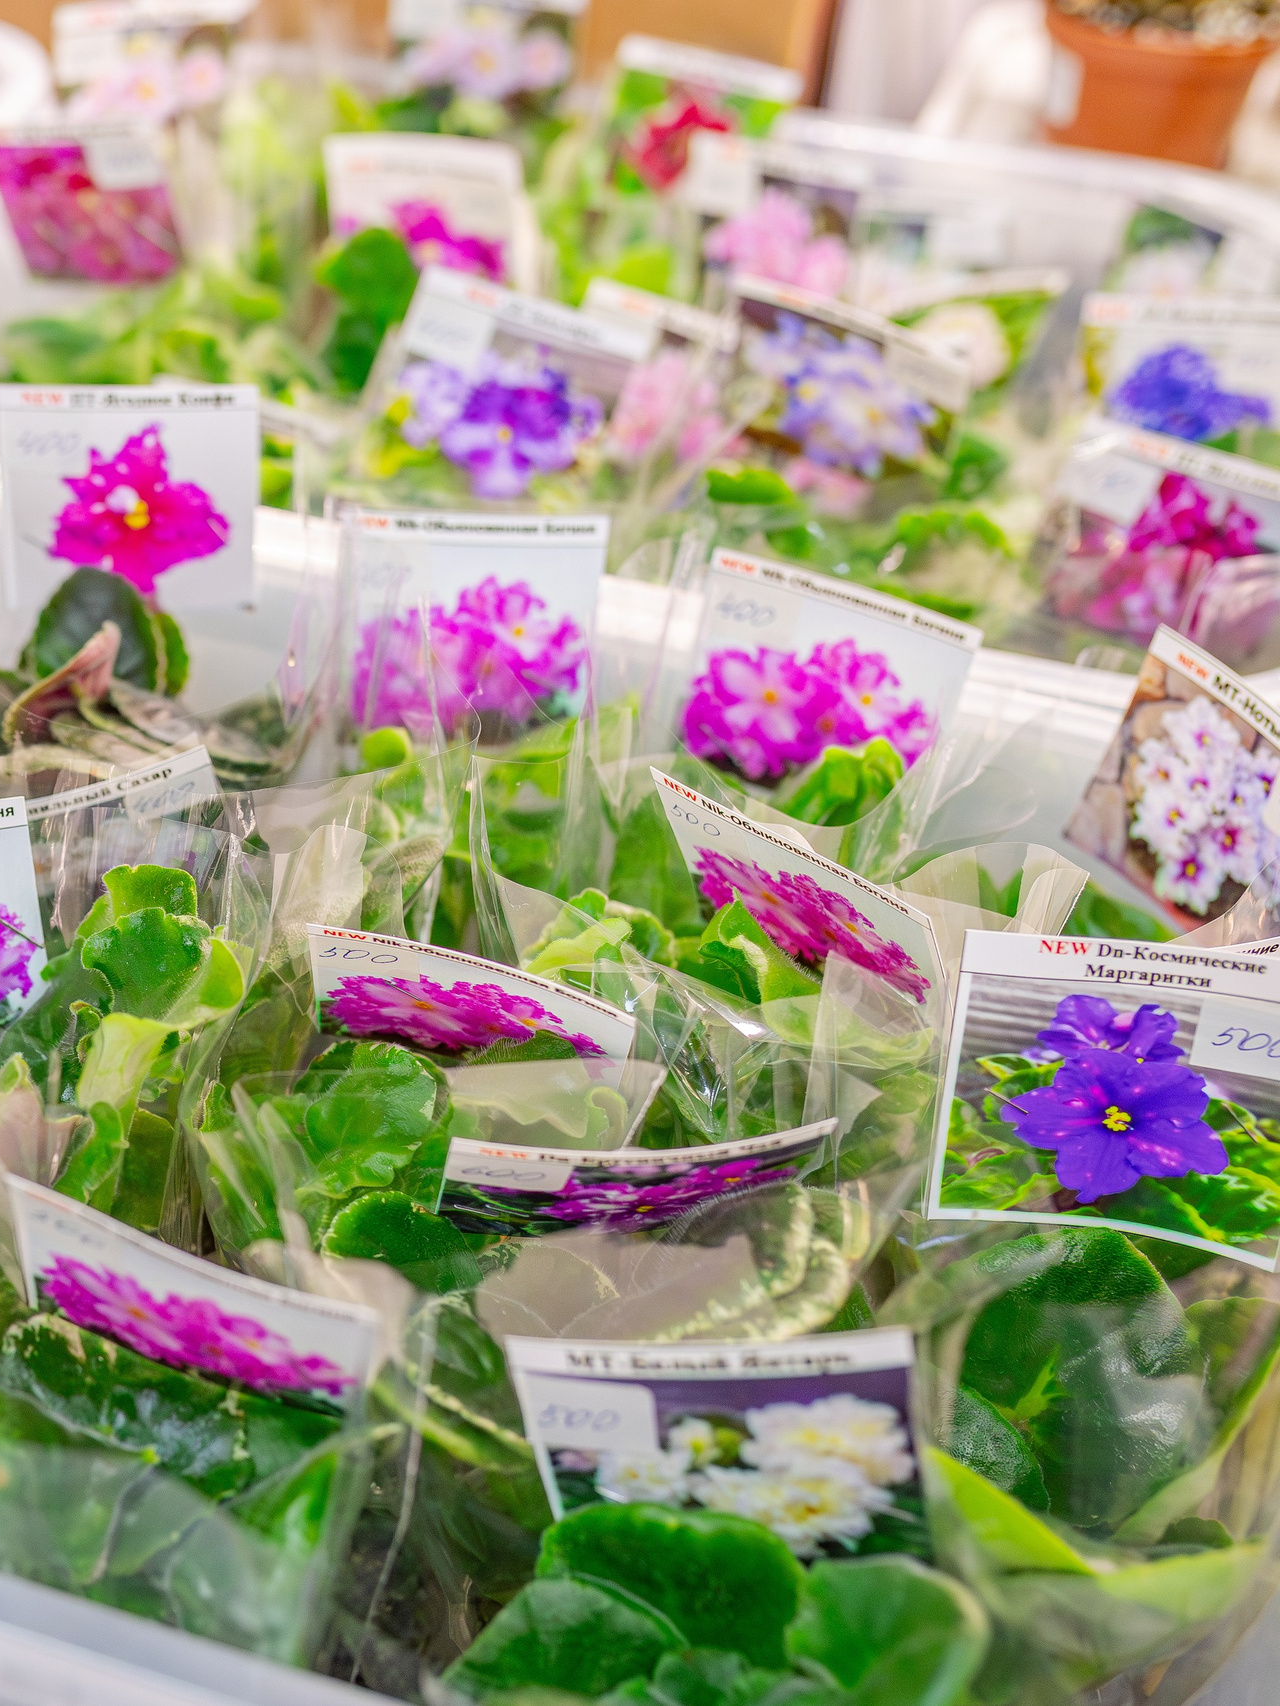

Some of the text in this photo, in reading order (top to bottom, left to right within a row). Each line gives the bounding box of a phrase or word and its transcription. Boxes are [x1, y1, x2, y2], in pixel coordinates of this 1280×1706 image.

[670, 803, 721, 837] 500
[663, 777, 909, 916] NEW Nik-Обыкновенная Богиня
[318, 946, 399, 965] 500
[1038, 939, 1268, 976] NEW Dn-Космические
[323, 929, 618, 1019] NEW Nik-Обыкновенная Богиня
[1084, 963, 1212, 988] Маргаритки
[461, 1165, 546, 1182] 600
